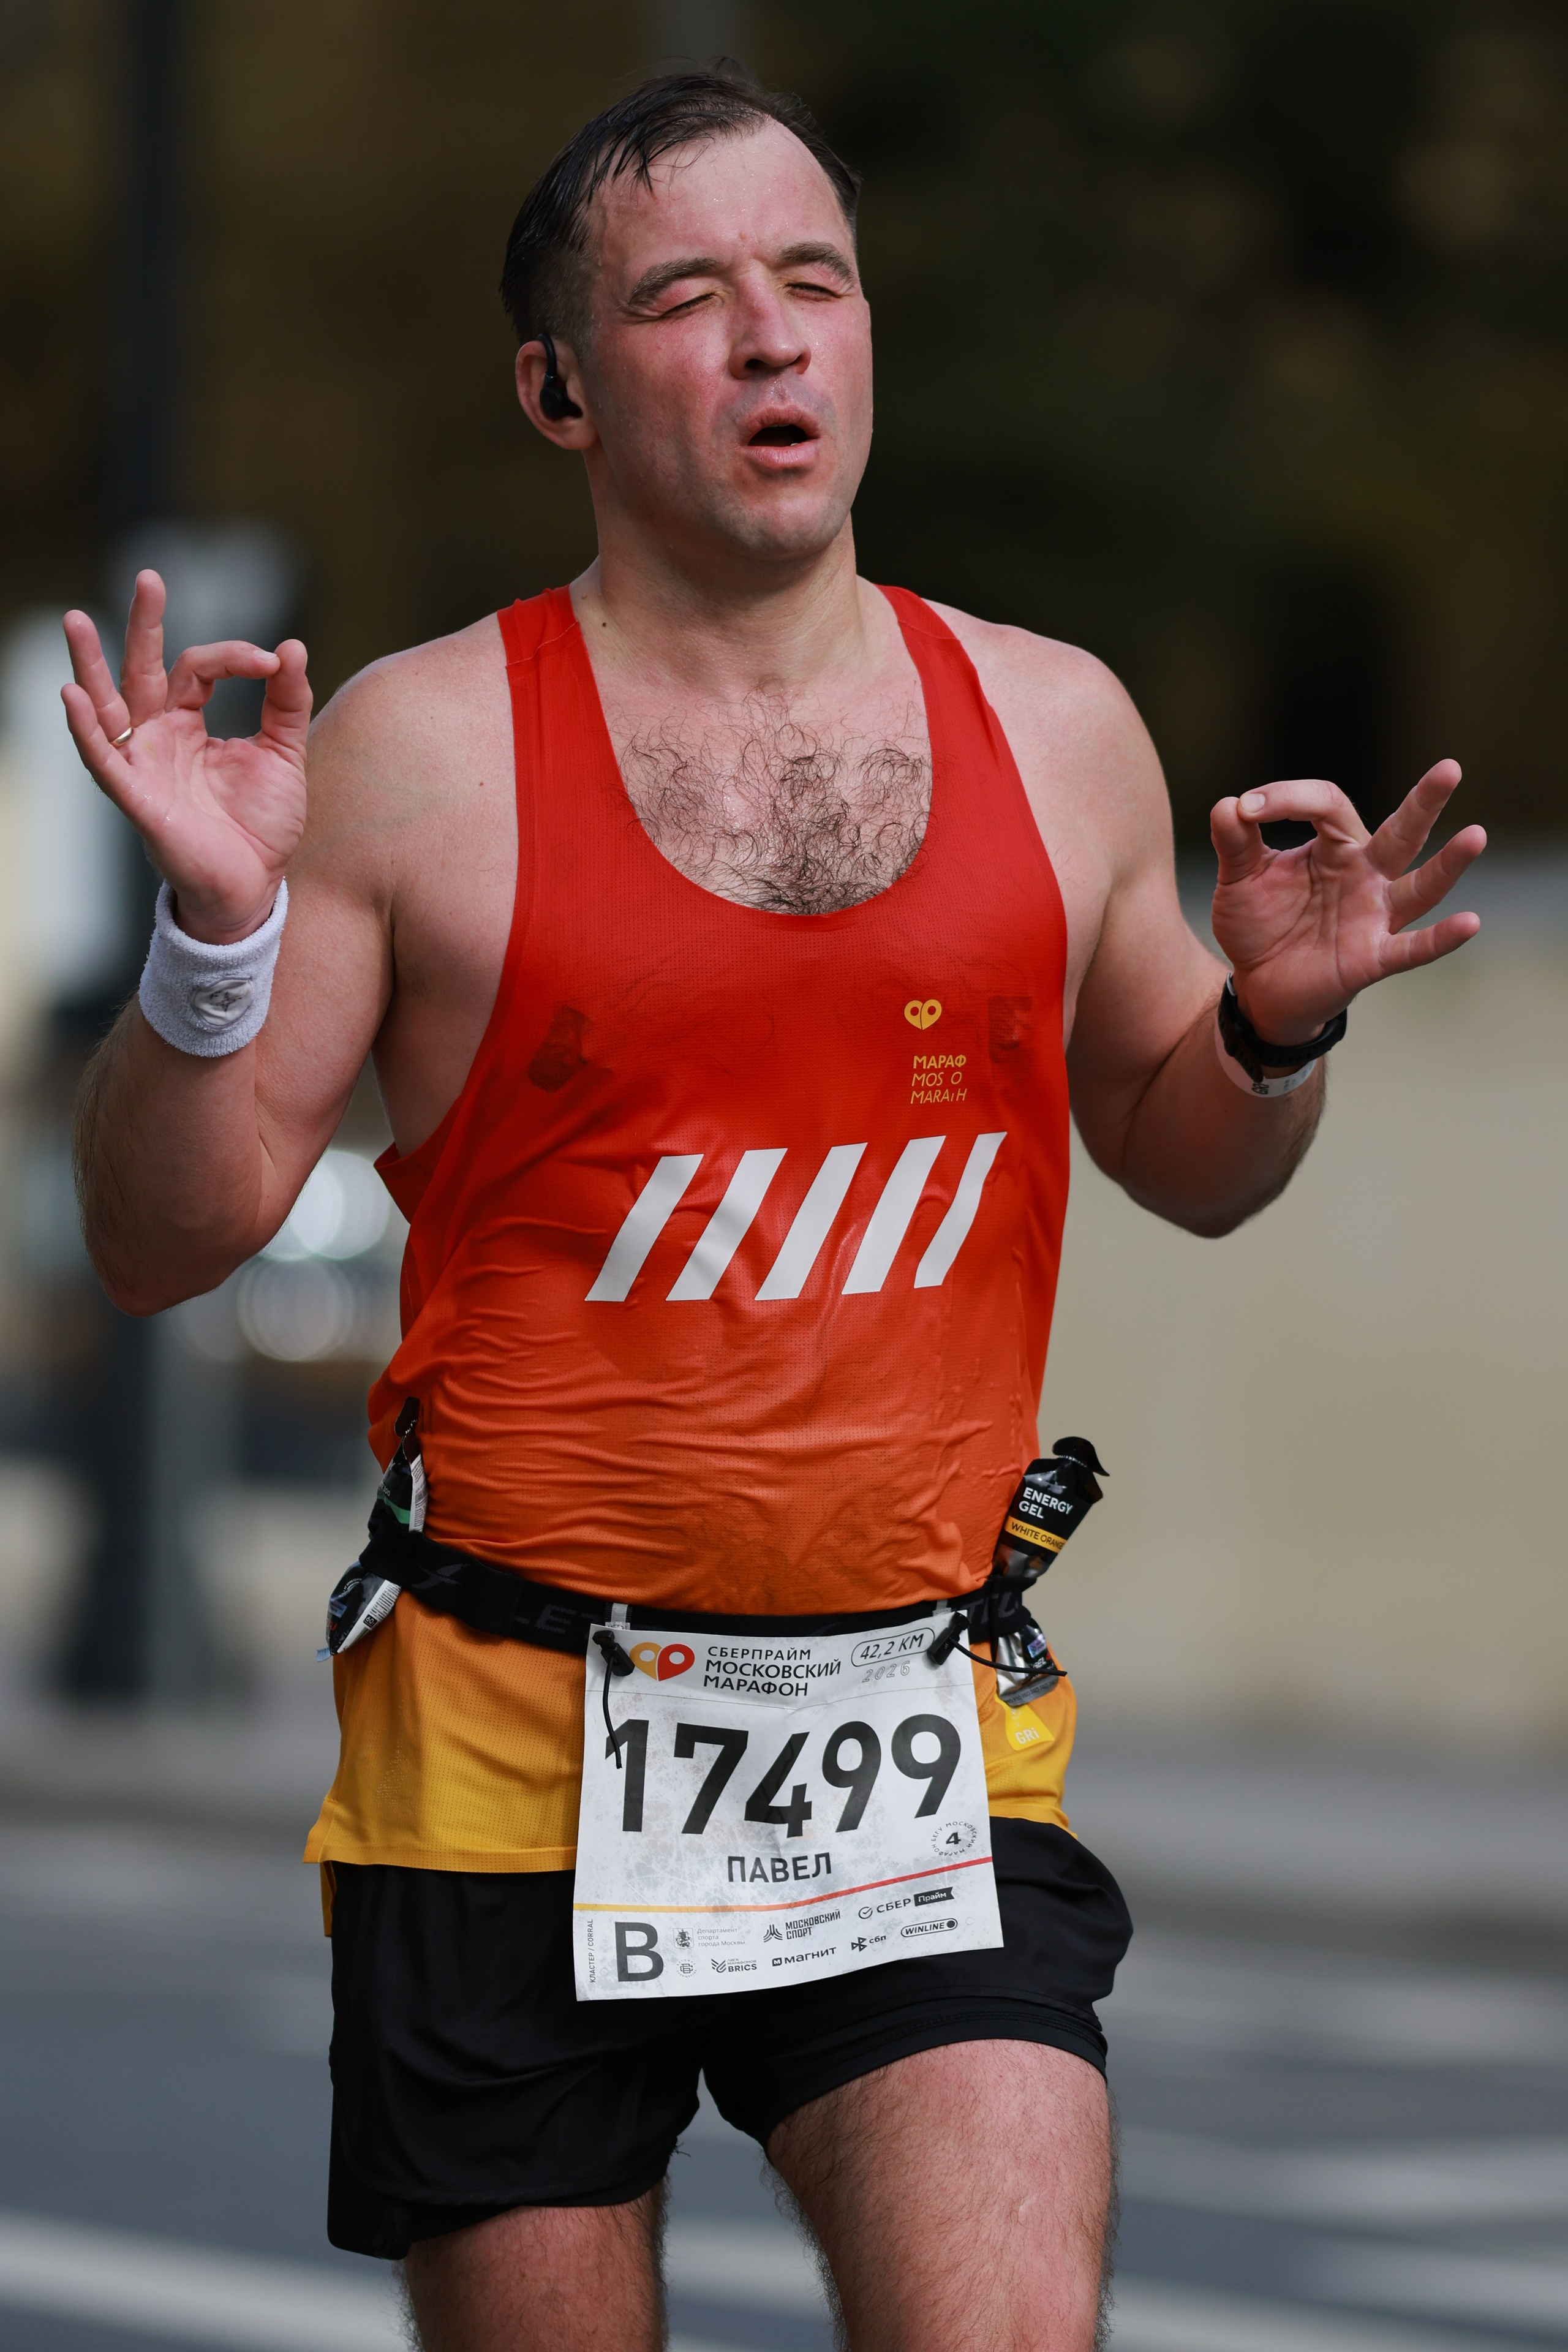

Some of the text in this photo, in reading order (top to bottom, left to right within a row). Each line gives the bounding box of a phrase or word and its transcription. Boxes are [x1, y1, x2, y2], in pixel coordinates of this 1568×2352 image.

[1019, 1501, 1044, 1519] GEL
[1023, 1487, 1074, 1515] ENERGY
[1012, 1521, 1041, 1540] WHITE
[707, 1646, 811, 1661] СБЕРПРАЙМ
[860, 1641, 895, 1659] 42,2
[705, 1658, 842, 1679] МОСКОВСКИЙ
[862, 1660, 910, 1683] 2026
[703, 1675, 808, 1697] МАРАФОН
[605, 1713, 961, 1838] 17499
[931, 1826, 942, 1842] БЕГУ
[946, 1831, 961, 1845] 4
[728, 1852, 832, 1883] ПАВЕЛ
[876, 1891, 947, 1913] СБЕР Прайм
[785, 1909, 841, 1931] МОСКОВСКИЙ
[905, 1922, 944, 1935] WINLINE
[786, 1926, 812, 1940] СПОРТ
[869, 1935, 887, 1943] сбп
[728, 1964, 757, 1972] BRICS
